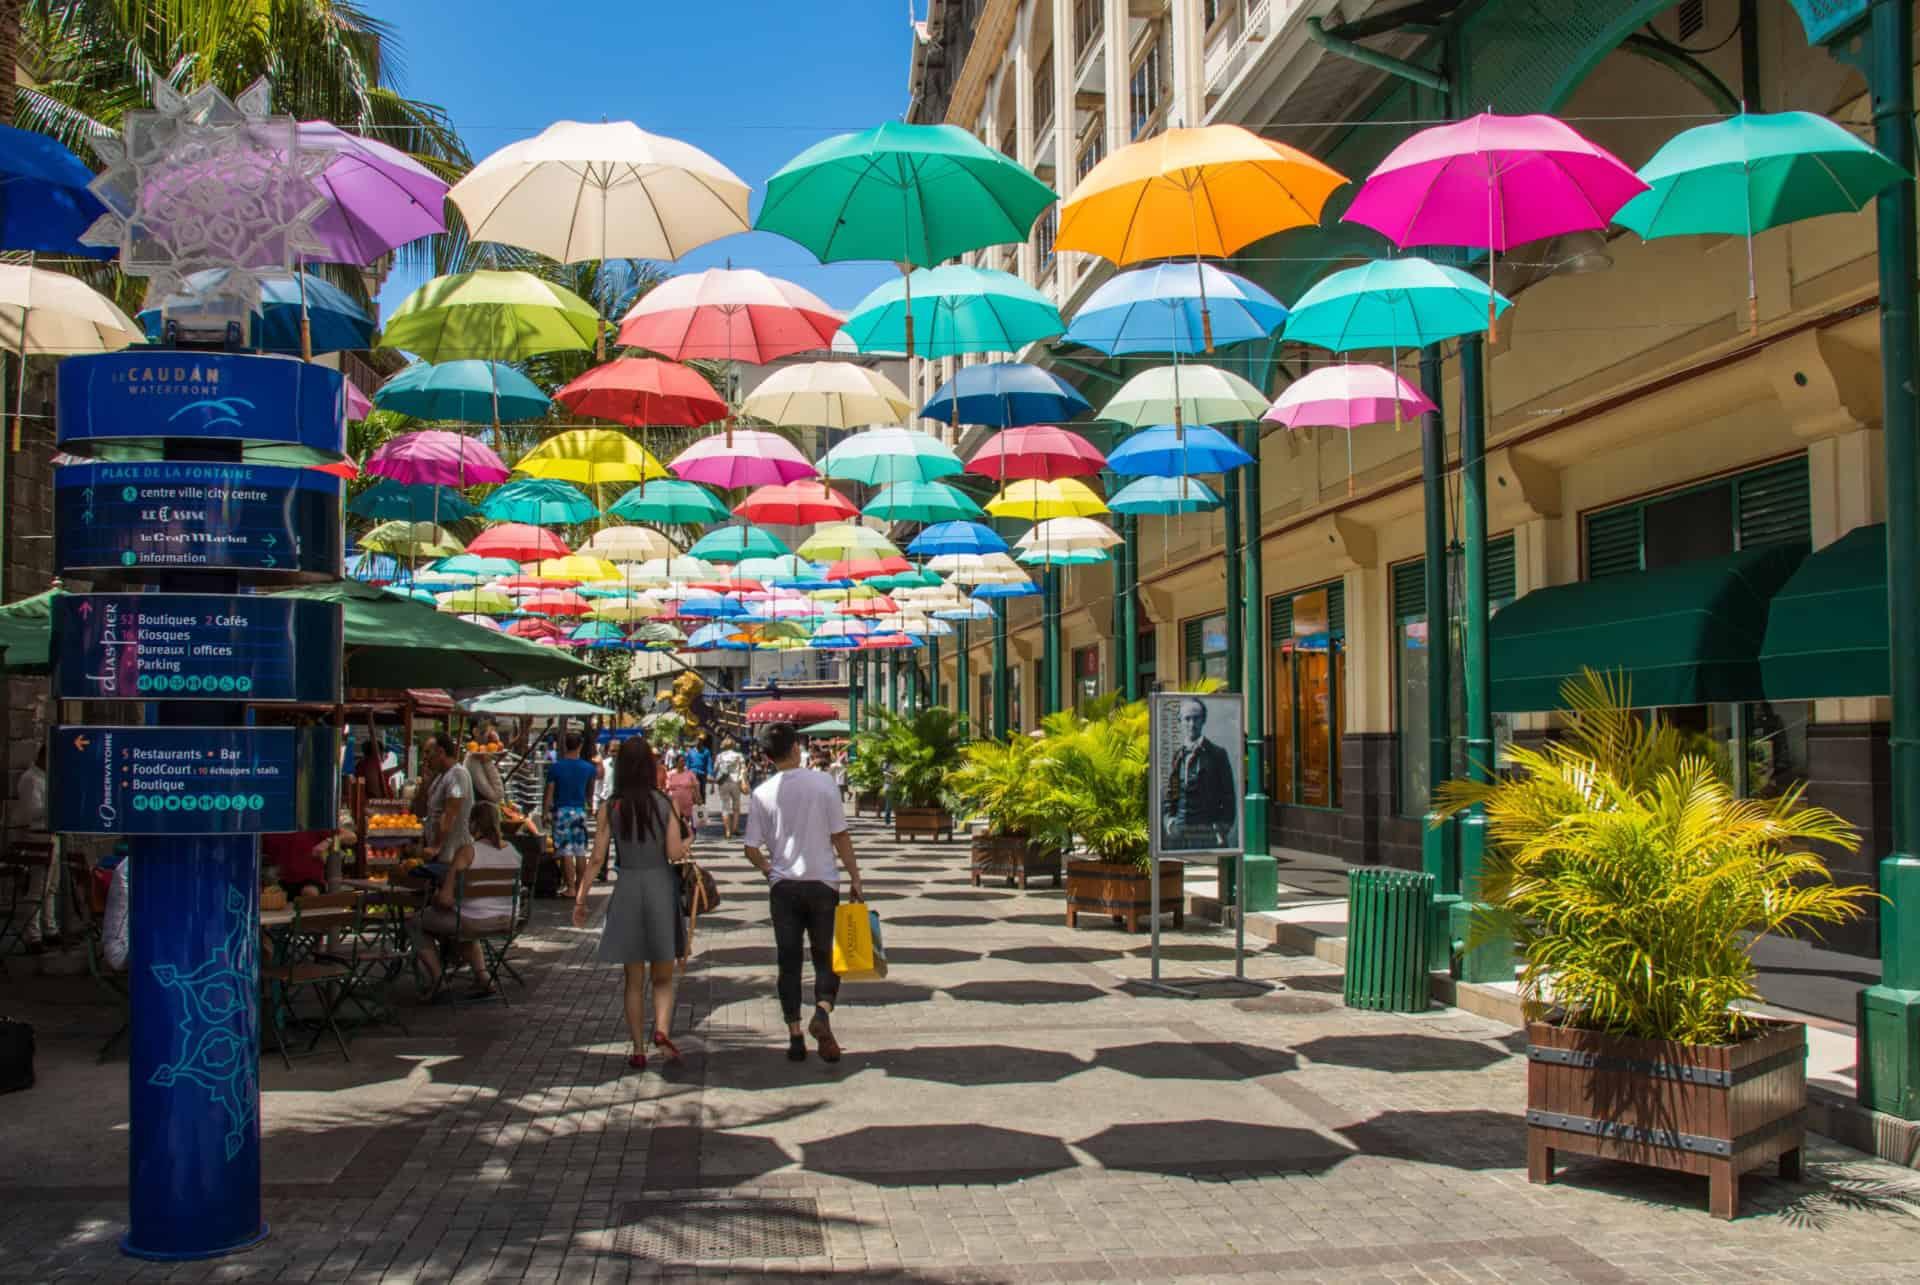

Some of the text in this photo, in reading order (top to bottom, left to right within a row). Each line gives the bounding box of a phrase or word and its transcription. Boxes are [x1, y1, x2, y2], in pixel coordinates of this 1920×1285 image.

[128, 366, 219, 384] CAUDAN
[128, 385, 218, 396] WATERFRONT
[101, 467, 253, 480] PLACE DE LA FONTAINE
[141, 488, 268, 502] centre ville city centre
[139, 551, 207, 563] information
[137, 614, 197, 626] Boutiques
[205, 615, 213, 625] 2
[215, 614, 249, 627] Cafés
[137, 629, 191, 642] Kiosques
[137, 644, 233, 657] Bureaux offices
[137, 659, 181, 672] Parking
[132, 747, 202, 760] Restaurants
[220, 748, 241, 760] Bar
[132, 763, 191, 776] FoodCourt
[132, 778, 185, 792] Boutique
